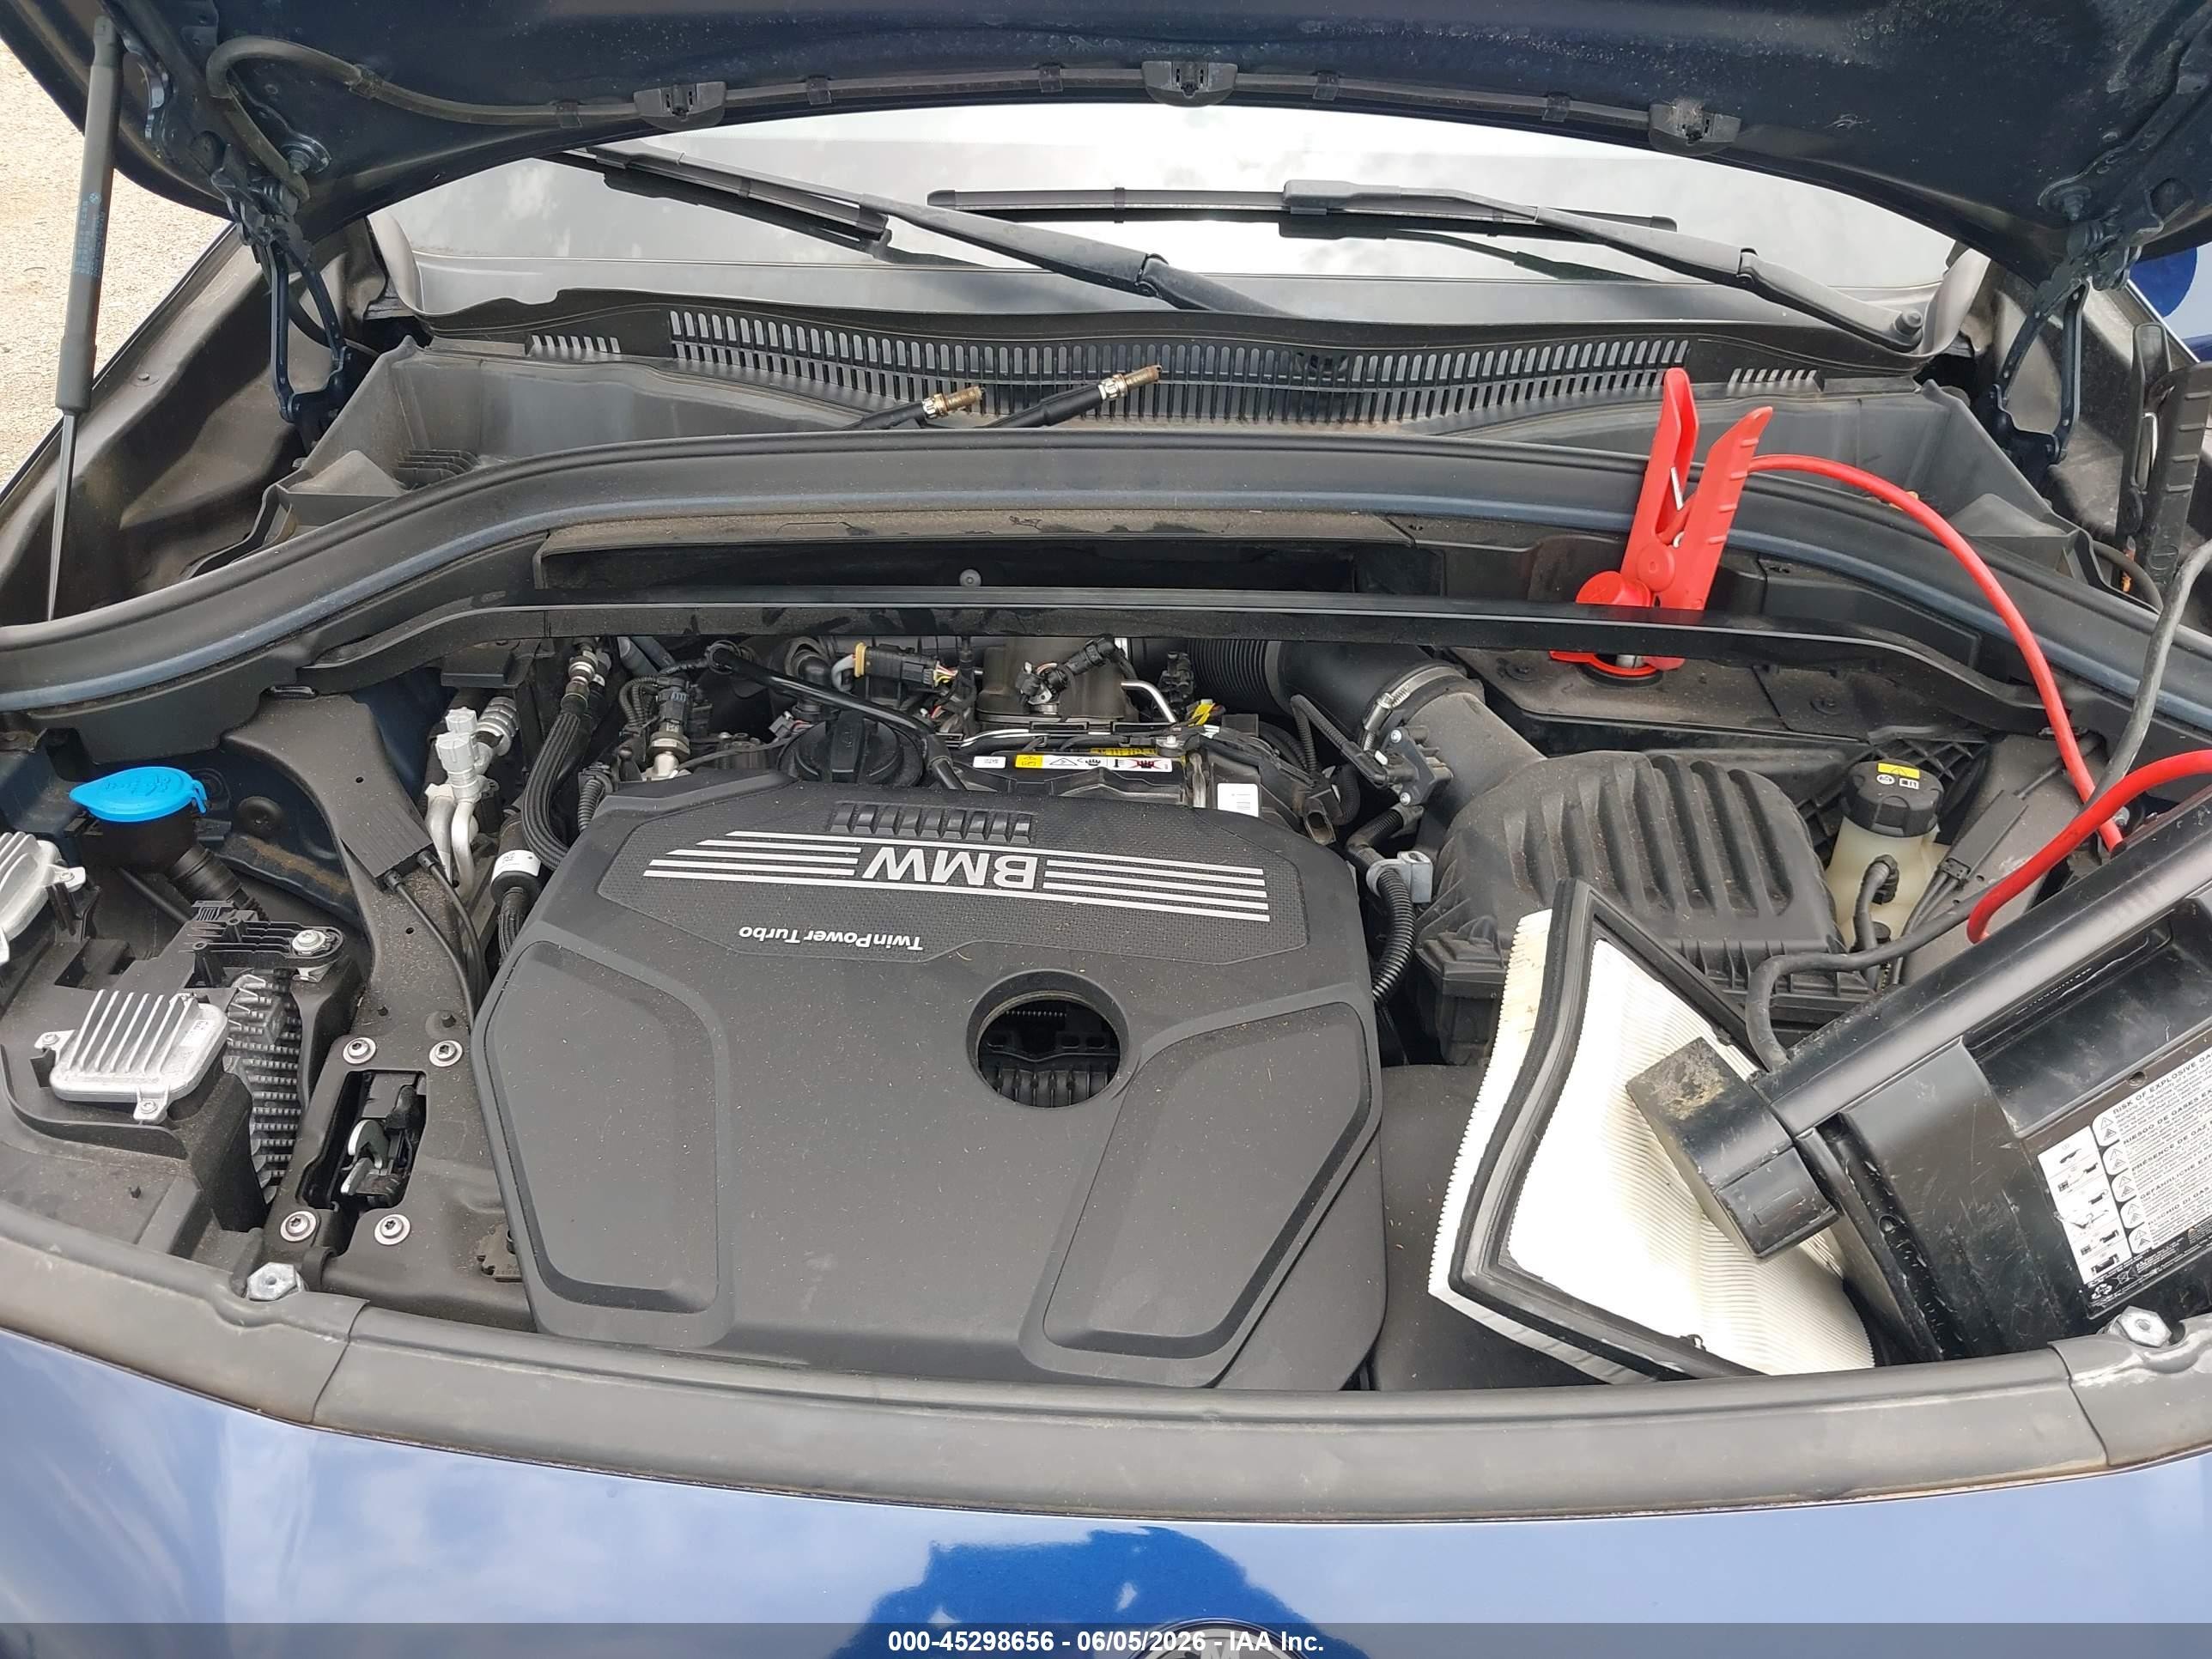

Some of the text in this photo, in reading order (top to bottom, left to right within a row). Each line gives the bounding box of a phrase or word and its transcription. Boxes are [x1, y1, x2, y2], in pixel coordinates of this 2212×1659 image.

[861, 846, 1038, 890] BMW
[738, 926, 800, 944] Turbo
[2112, 1100, 2133, 1115] RISK
[2136, 1091, 2147, 1101] OF
[2149, 1061, 2196, 1093] EXPLOSIVE
[2124, 1124, 2154, 1145] RIESGO
[2157, 1115, 2169, 1125] DE
[2171, 1097, 2199, 1115] GASES
[2177, 1135, 2189, 1145] DE
[2191, 1124, 2207, 1136] GAZ
[2193, 1187, 2209, 1198] GAS
